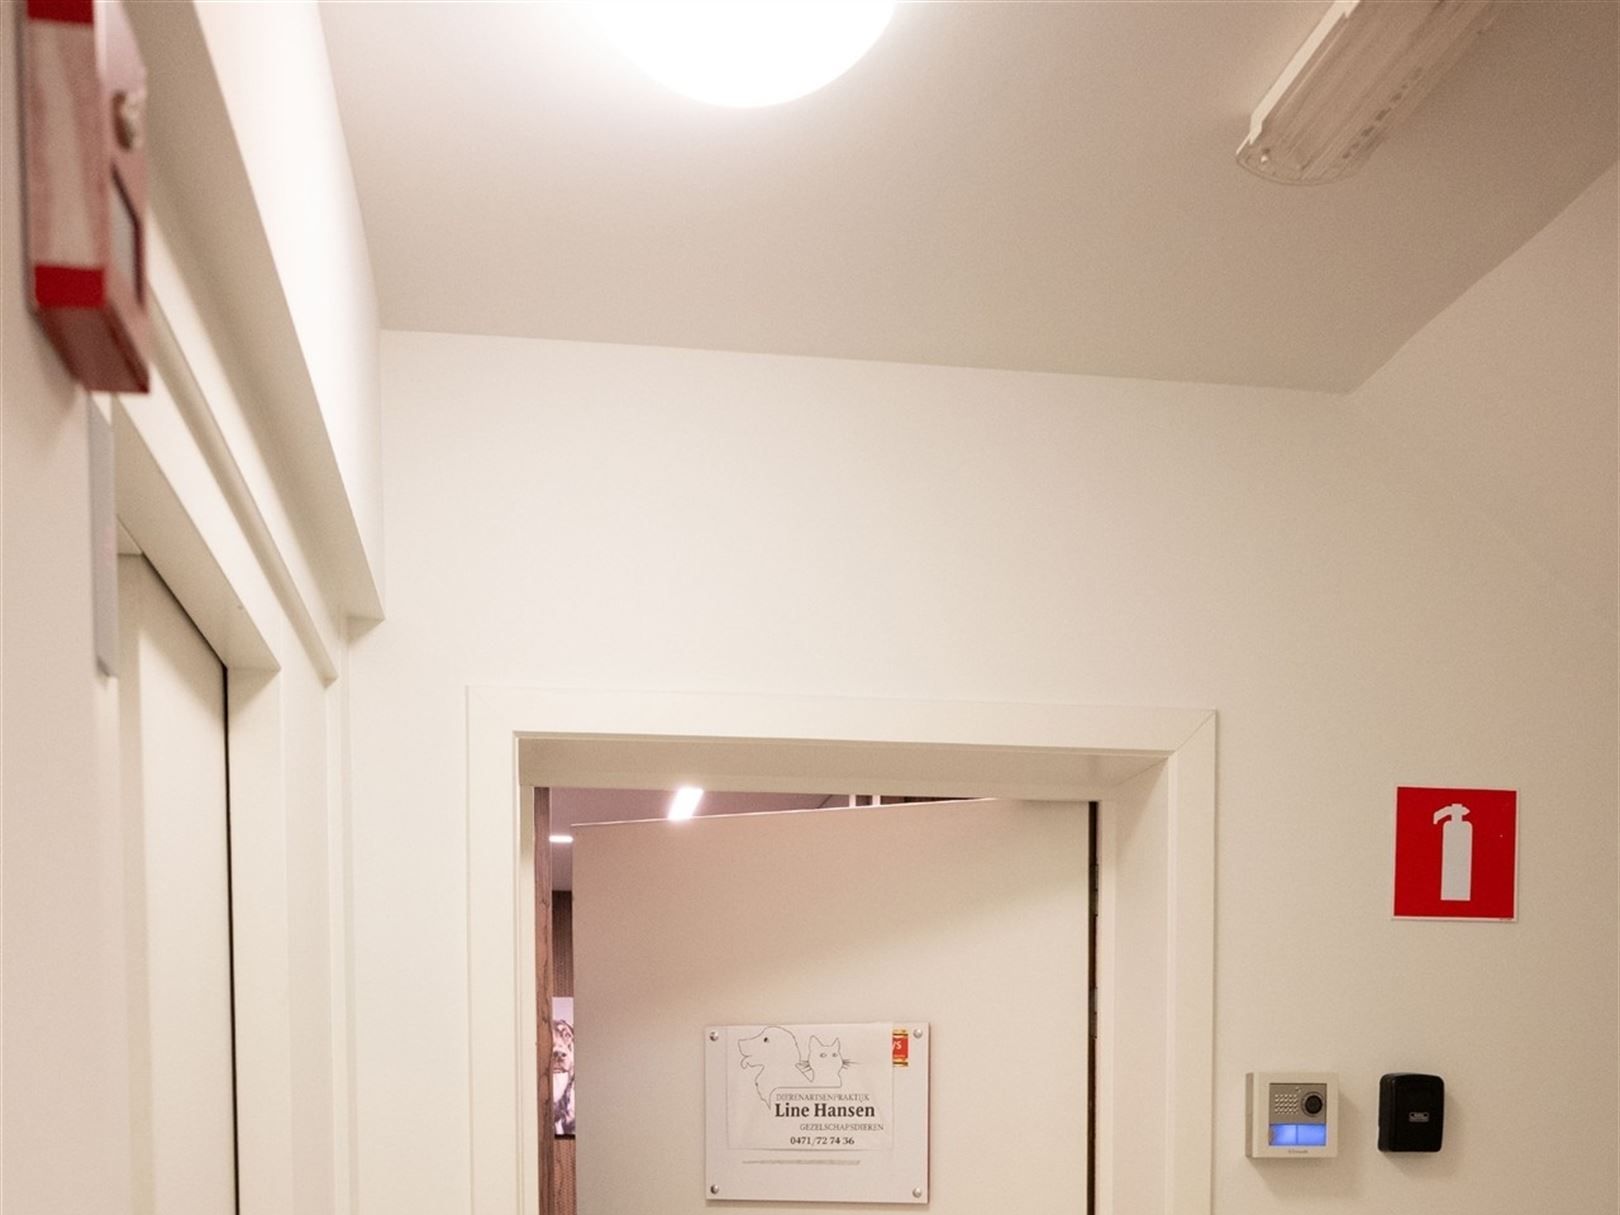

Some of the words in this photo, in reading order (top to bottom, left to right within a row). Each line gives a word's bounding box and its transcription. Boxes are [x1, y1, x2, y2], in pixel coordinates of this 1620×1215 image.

[775, 1102, 810, 1118] Line
[814, 1103, 875, 1118] Hansen
[800, 1123, 884, 1131] GEZELSCHAPSDIEREN
[790, 1136, 828, 1146] 0471/72
[830, 1136, 841, 1145] 74
[842, 1136, 855, 1145] 36
